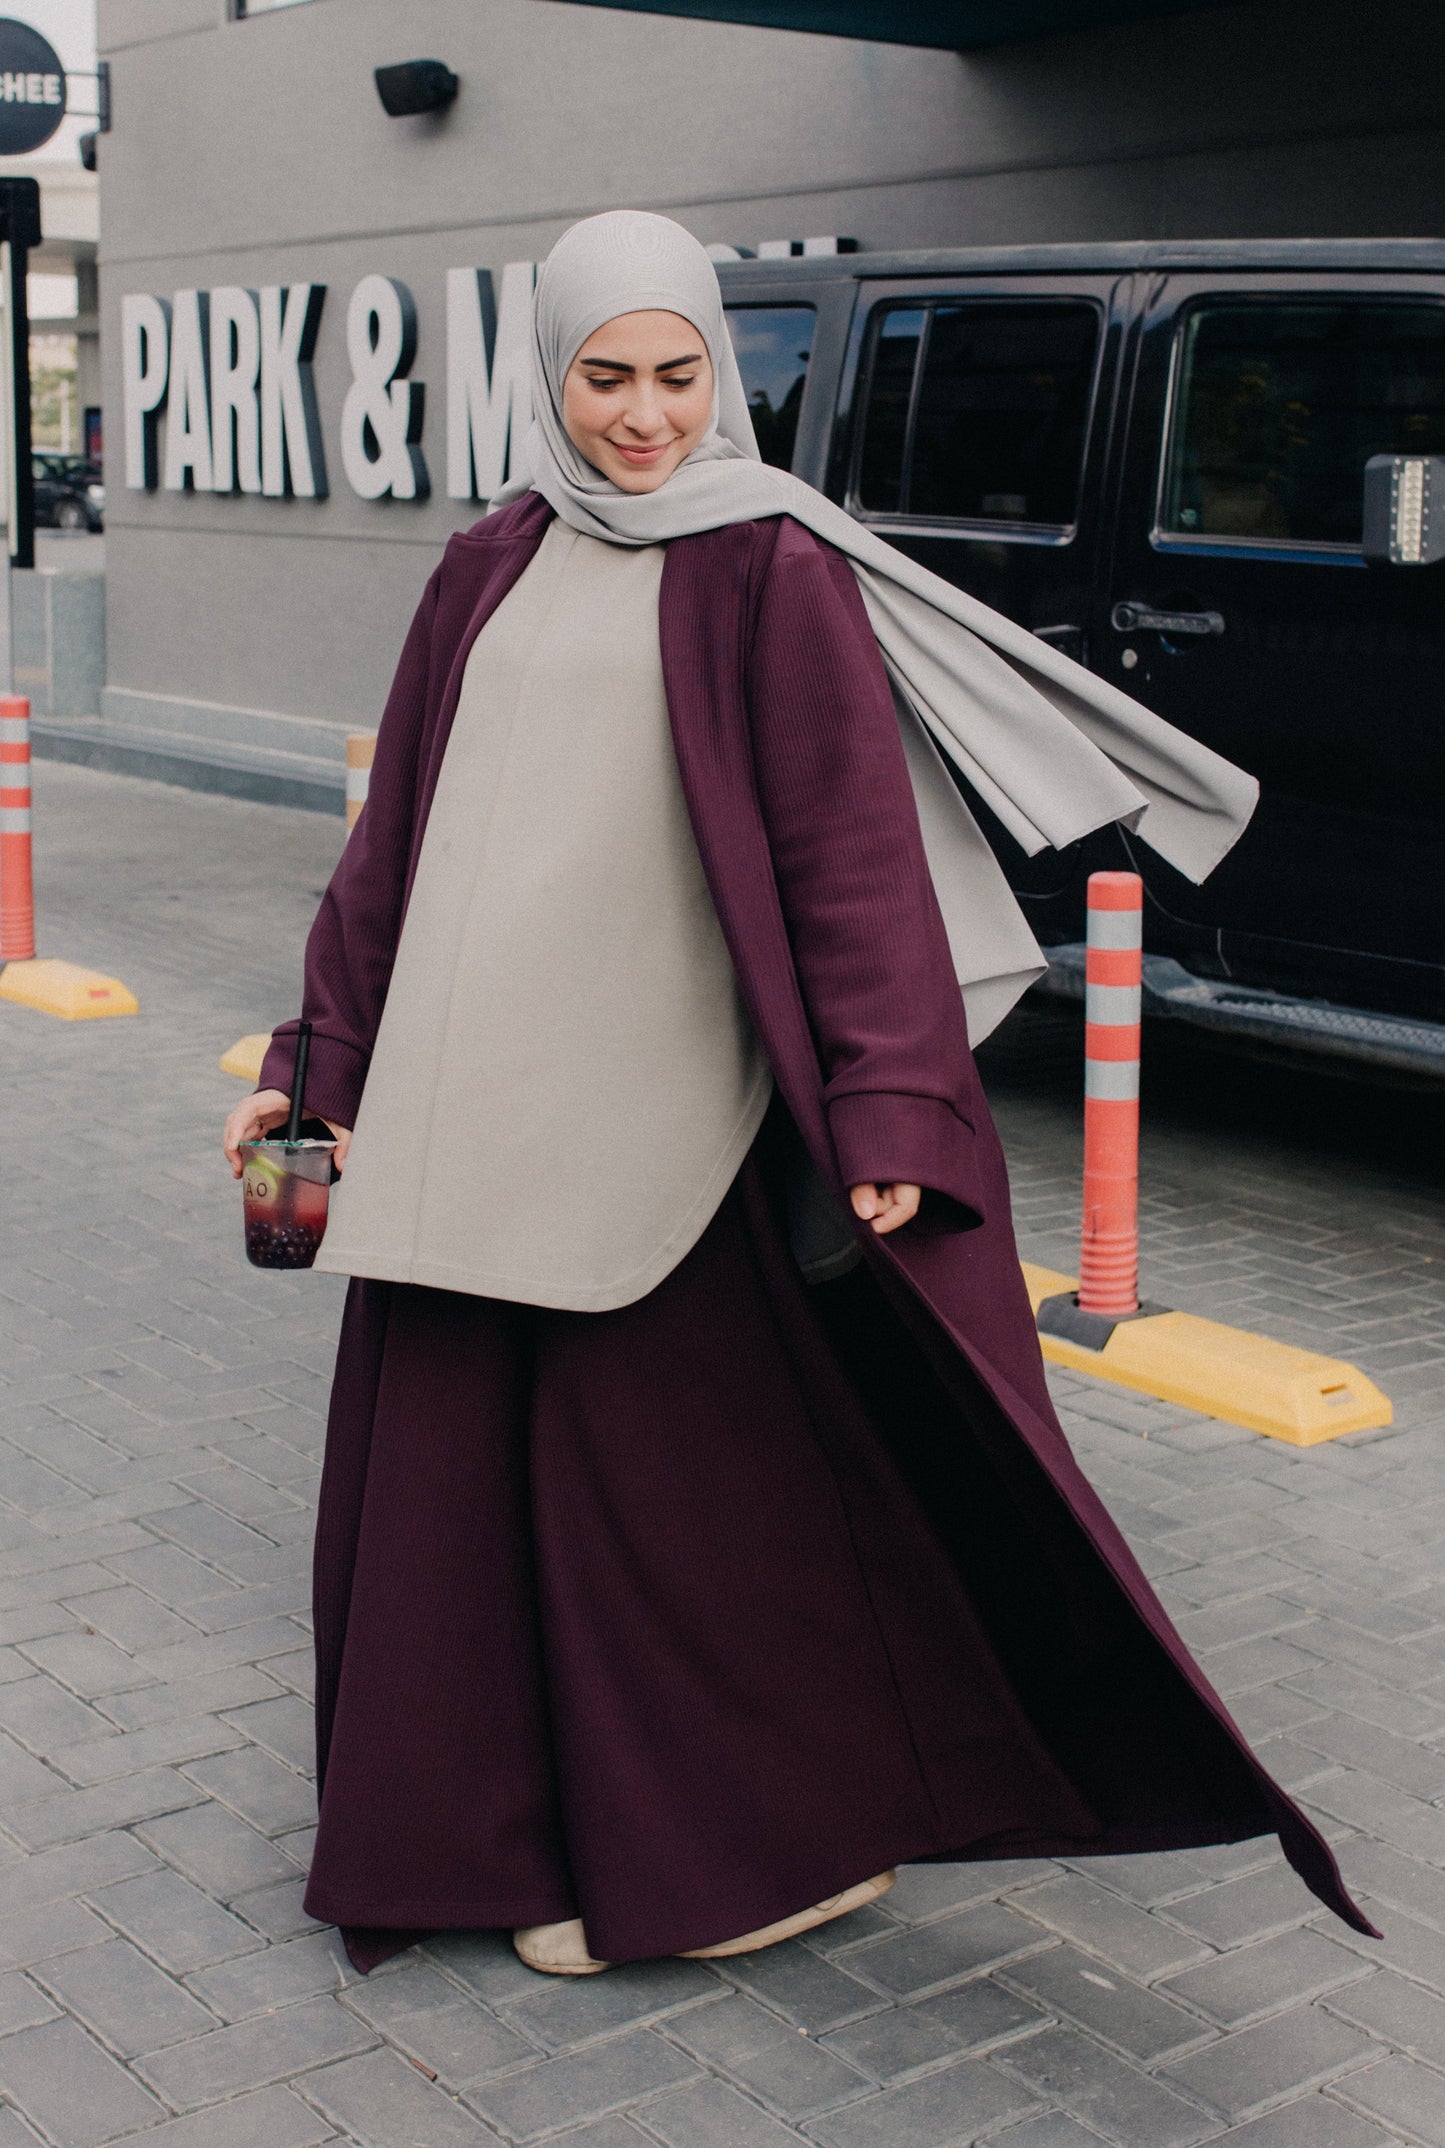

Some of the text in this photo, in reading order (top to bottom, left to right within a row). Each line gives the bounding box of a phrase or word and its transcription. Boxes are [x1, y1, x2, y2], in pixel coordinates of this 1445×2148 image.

[122, 262, 540, 500] PARK & M
